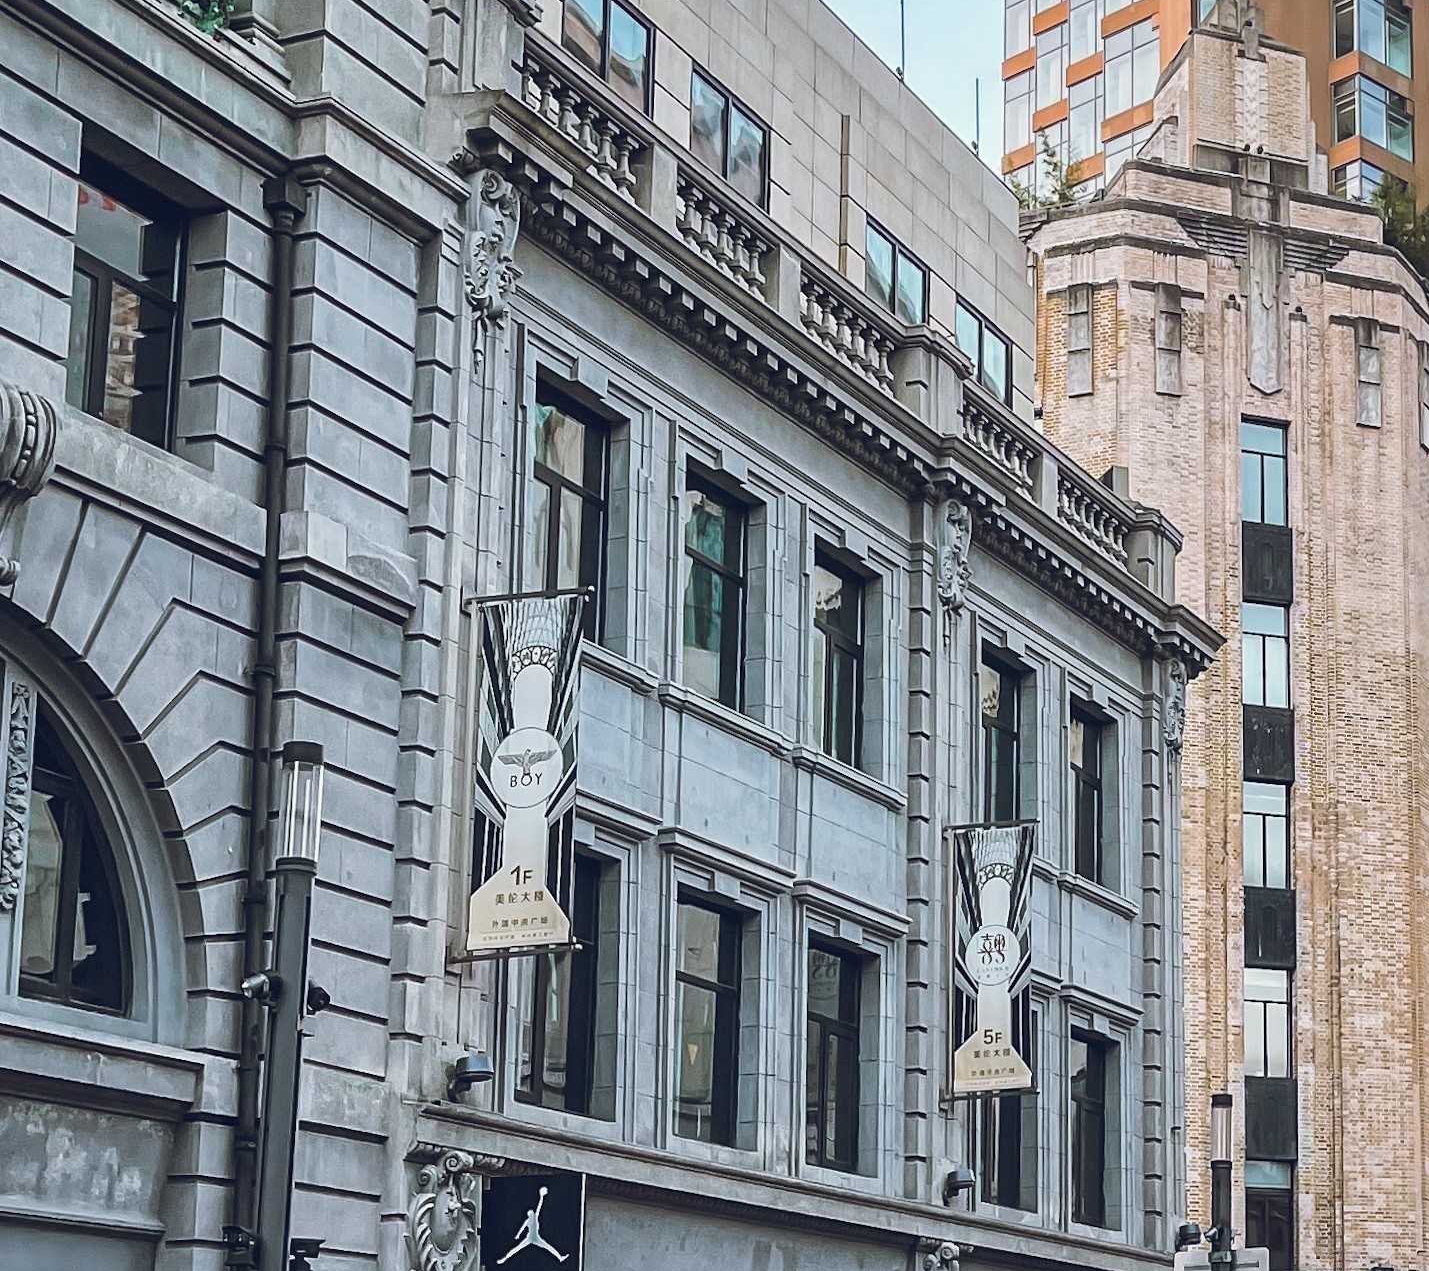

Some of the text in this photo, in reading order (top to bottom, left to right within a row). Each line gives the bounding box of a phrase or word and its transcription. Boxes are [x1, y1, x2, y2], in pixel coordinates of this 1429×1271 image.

[510, 772, 543, 788] BOY
[510, 865, 534, 886] 1F
[983, 1028, 1003, 1045] 5F
